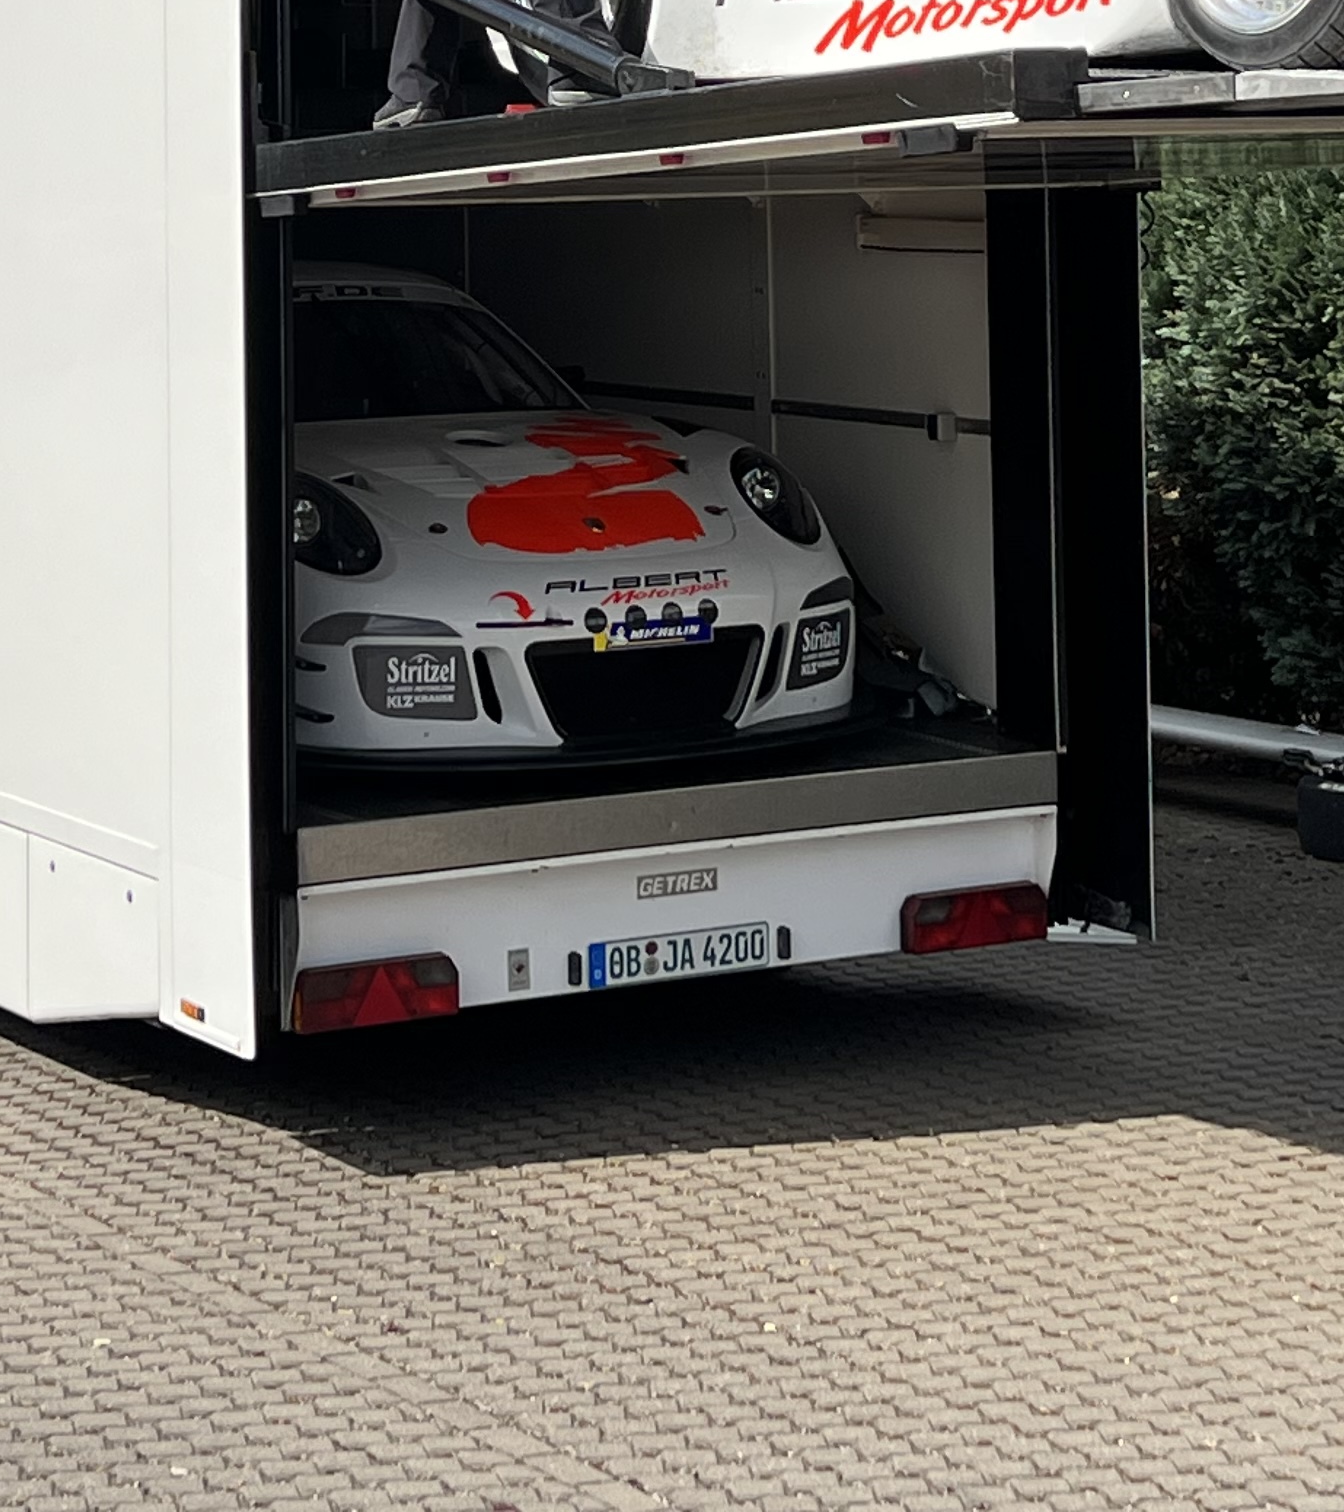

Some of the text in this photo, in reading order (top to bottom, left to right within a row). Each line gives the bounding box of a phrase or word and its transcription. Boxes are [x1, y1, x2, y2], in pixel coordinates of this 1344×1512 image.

[545, 568, 727, 594] ALBERT
[600, 579, 731, 606] Motorsport
[387, 656, 456, 683] Stritzel
[386, 694, 414, 709] KLZ
[639, 871, 714, 896] GETREX
[609, 945, 641, 979] OB
[662, 937, 695, 973] JA
[703, 929, 765, 967] 4200
